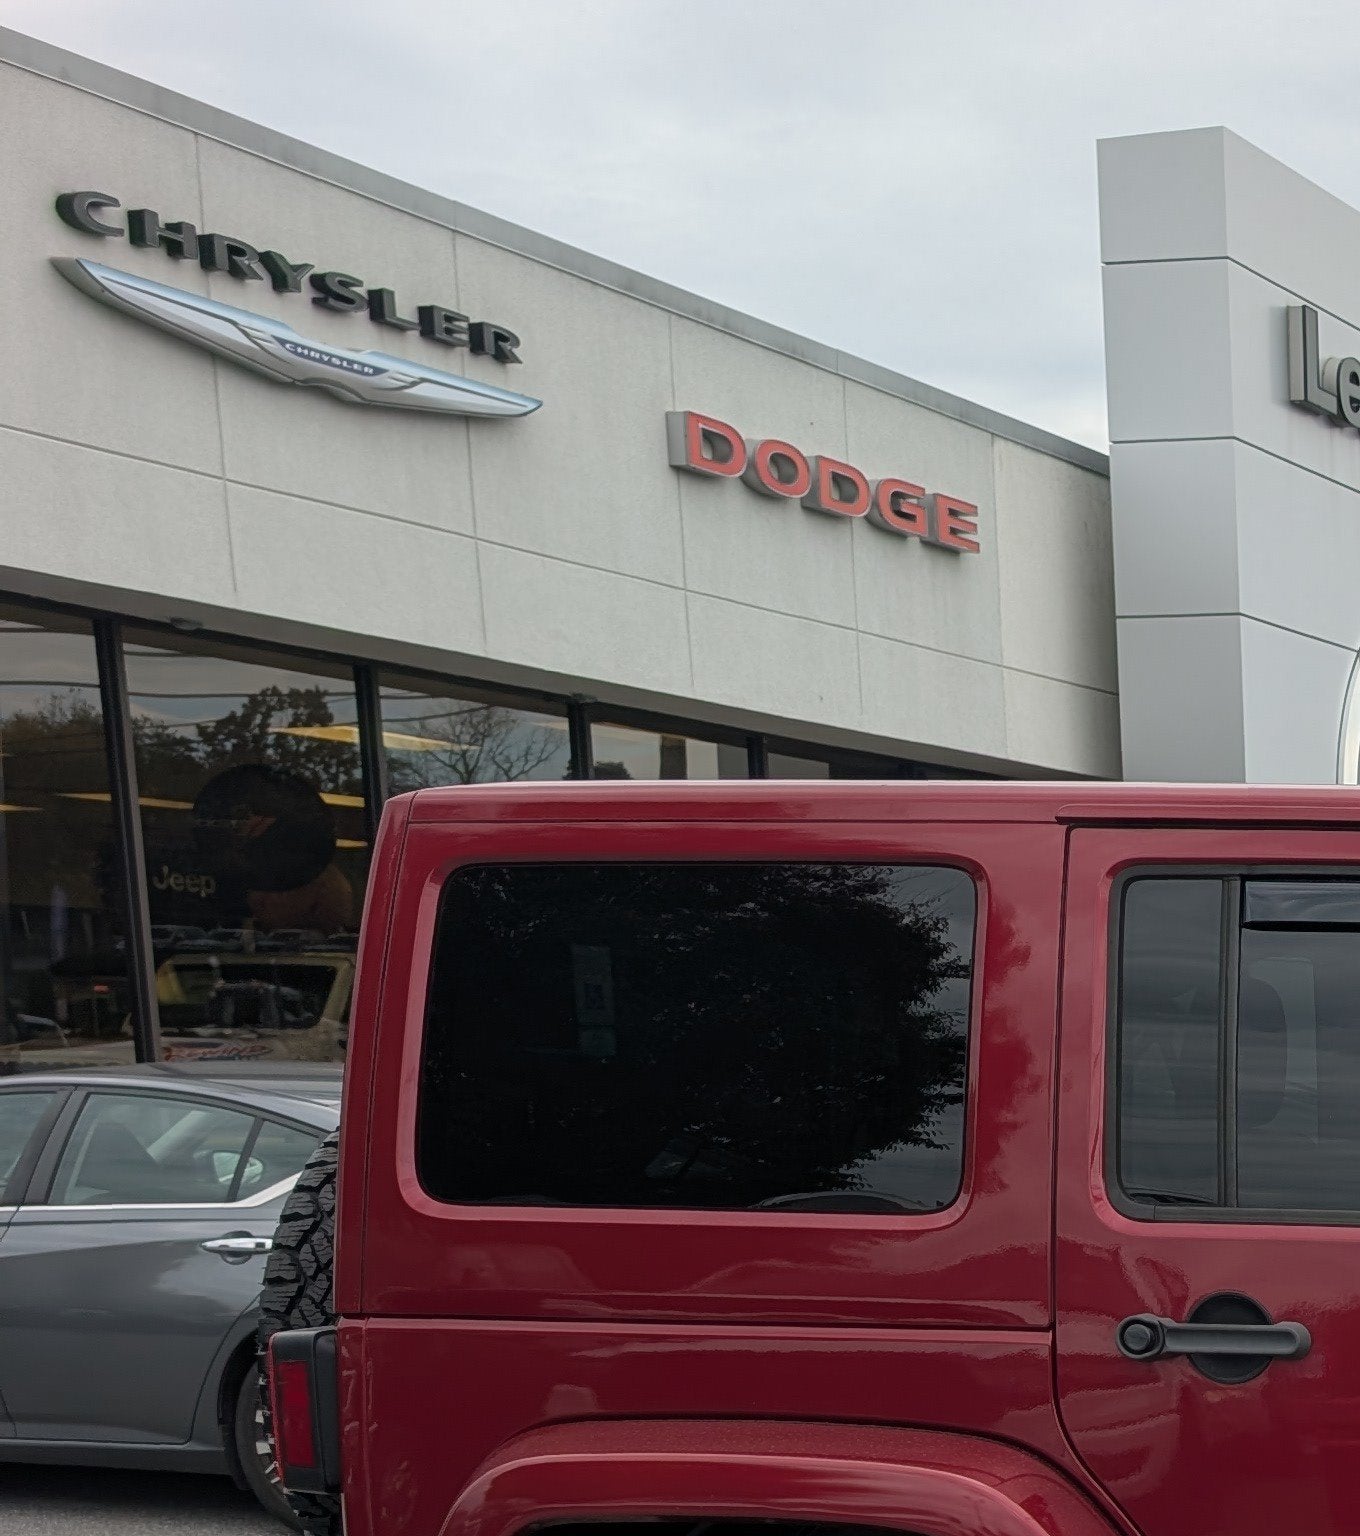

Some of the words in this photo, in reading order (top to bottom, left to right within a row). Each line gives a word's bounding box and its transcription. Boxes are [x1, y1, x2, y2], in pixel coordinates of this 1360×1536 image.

[55, 190, 523, 365] CHRYSLER
[666, 410, 980, 554] DODGE
[152, 866, 216, 897] Jeep
